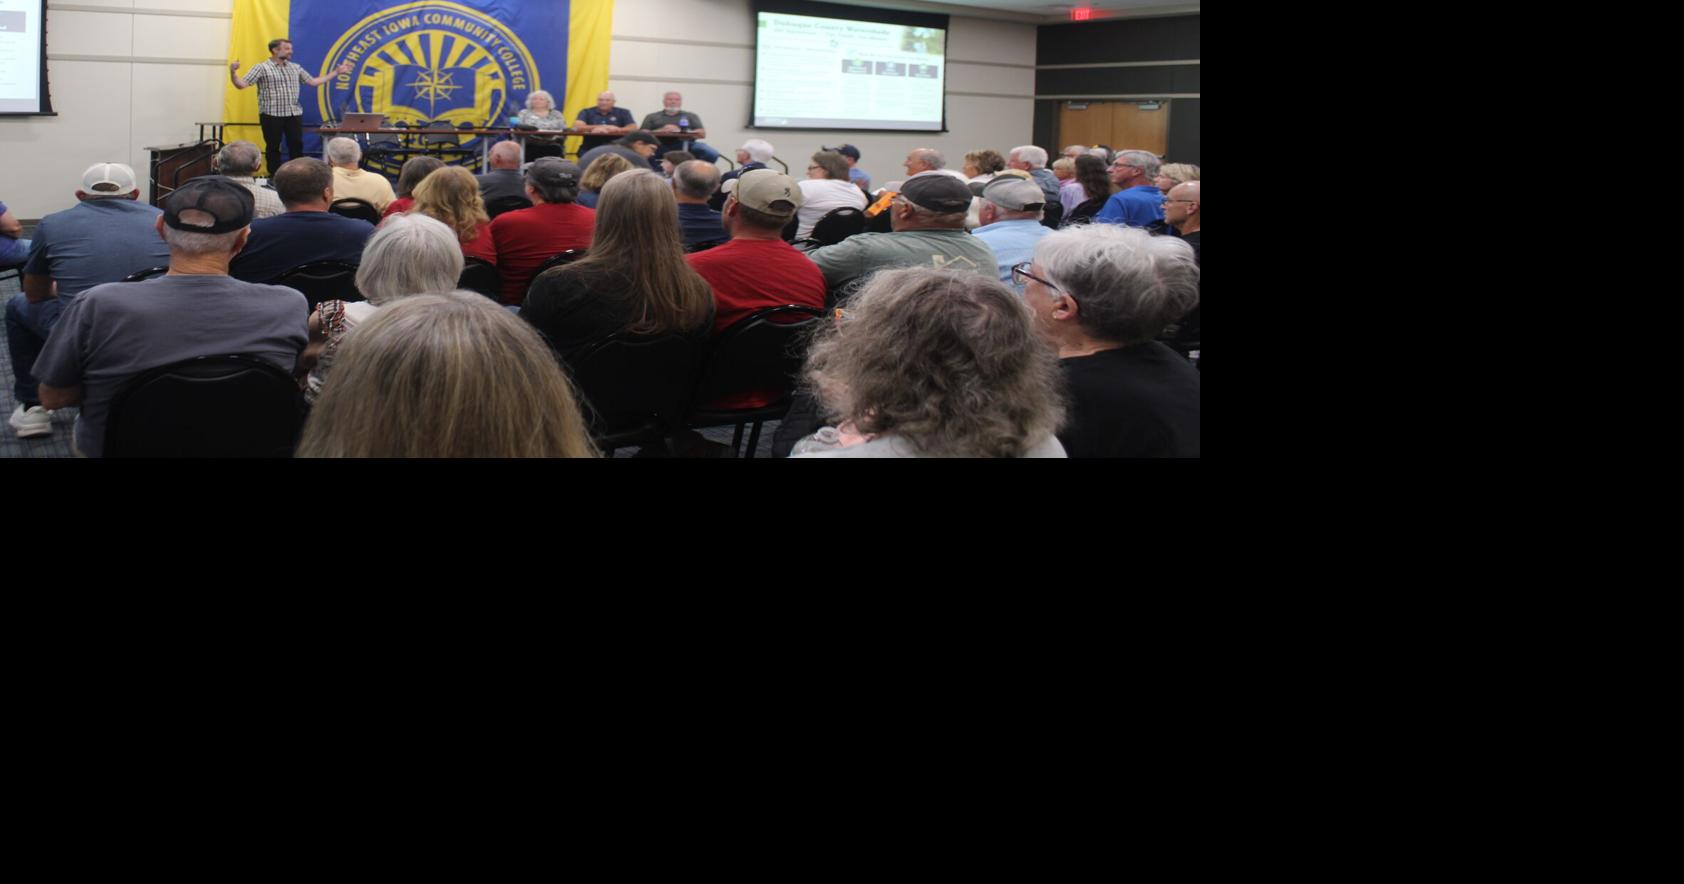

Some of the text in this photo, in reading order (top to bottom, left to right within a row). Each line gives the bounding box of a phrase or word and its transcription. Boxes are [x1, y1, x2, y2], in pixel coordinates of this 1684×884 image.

[1075, 8, 1090, 20] EXIT
[335, 13, 526, 90] NOTHEAST IOWA COMMUNITY COLLEGE
